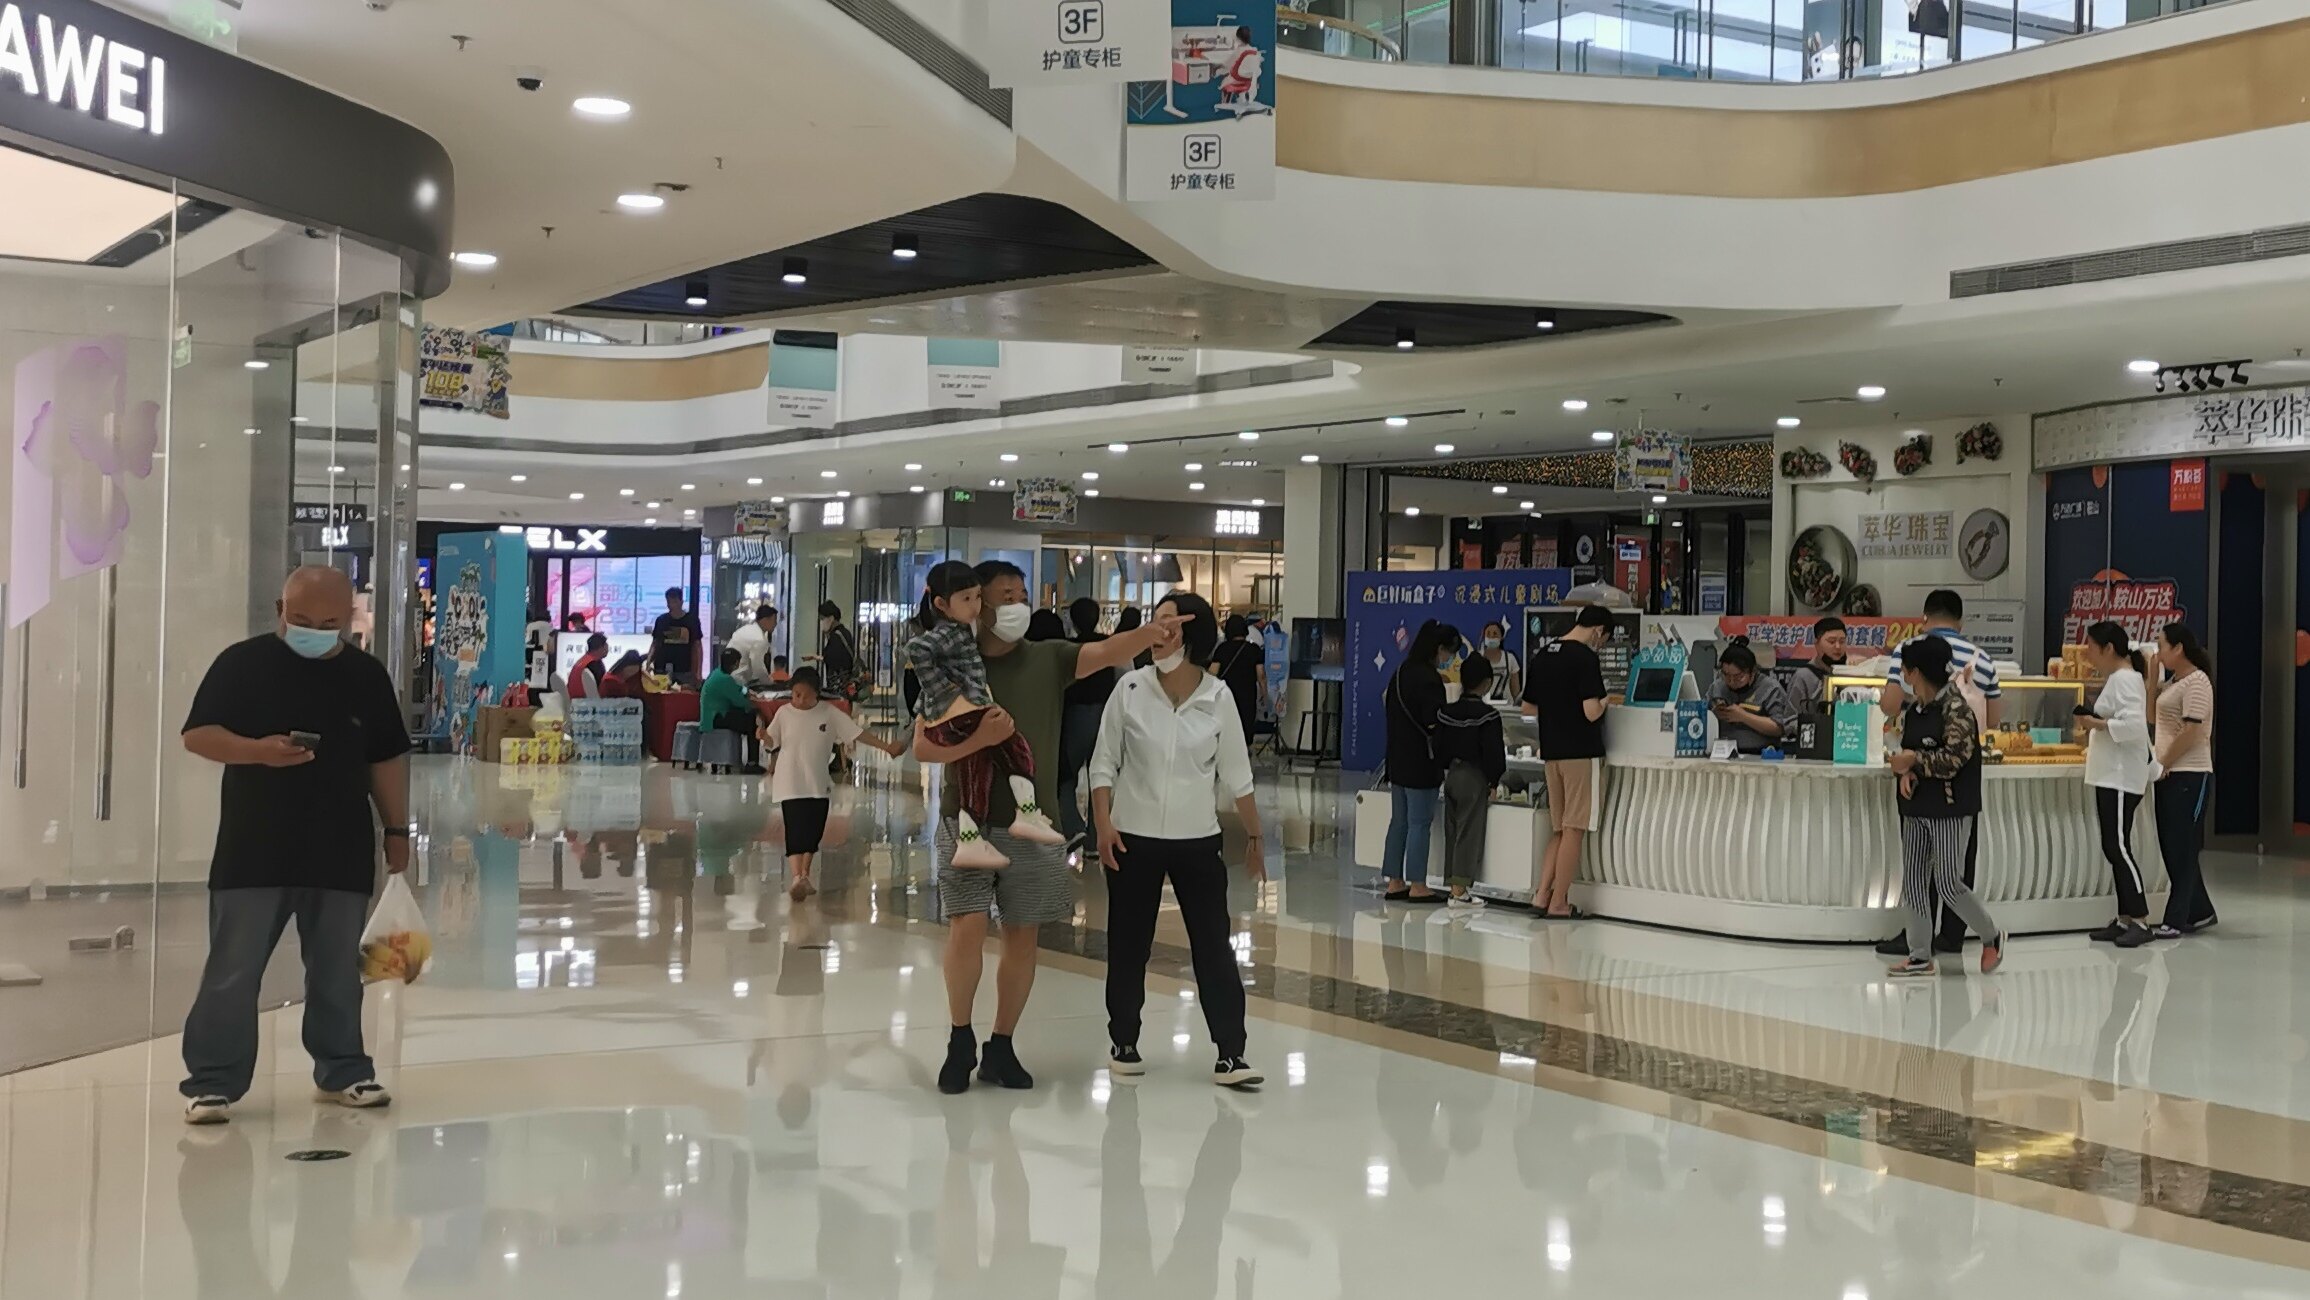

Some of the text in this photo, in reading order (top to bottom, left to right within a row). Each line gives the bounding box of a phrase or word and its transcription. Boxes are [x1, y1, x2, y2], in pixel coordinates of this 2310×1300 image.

[1064, 8, 1098, 35] 3F
[1043, 47, 1122, 71] 护童专柜
[1189, 141, 1217, 162] 3F
[1170, 173, 1235, 190] 护童专柜
[500, 525, 608, 551] ELX
[1864, 512, 1949, 542] 萃华珠宝
